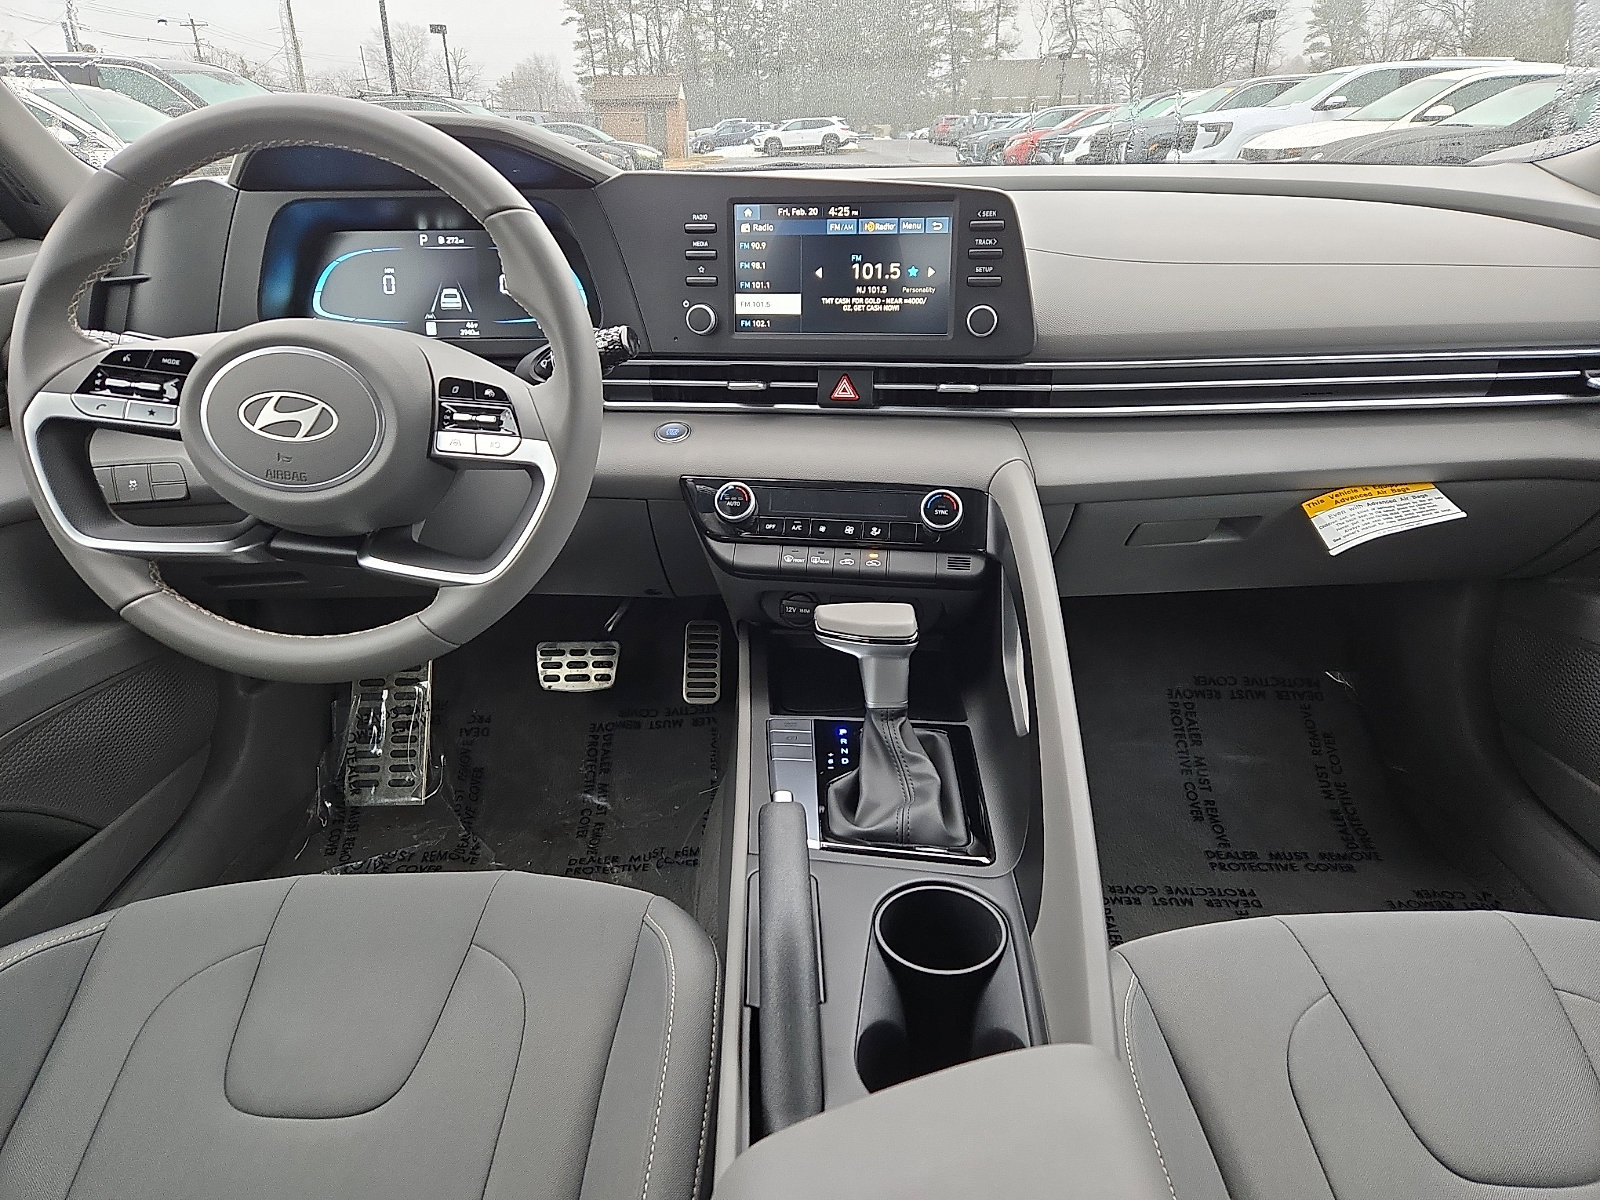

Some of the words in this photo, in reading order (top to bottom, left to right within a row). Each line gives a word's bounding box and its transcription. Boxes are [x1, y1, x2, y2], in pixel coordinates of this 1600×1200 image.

[777, 207, 791, 217] Fri,
[791, 207, 807, 216] Feb.
[808, 207, 819, 216] 20
[828, 206, 851, 217] 4:25
[752, 223, 774, 231] Radio
[829, 223, 854, 231] FM/AM
[902, 221, 921, 230] Menu
[419, 234, 428, 246] P
[739, 242, 750, 250] FM
[750, 241, 767, 250] 90.9
[851, 254, 862, 262] FM
[739, 261, 750, 269] FM
[750, 261, 766, 269] 98.1
[852, 262, 901, 280] 101.5
[382, 274, 396, 295] 0
[739, 281, 750, 289] FM
[751, 281, 770, 289] 101.1
[856, 286, 866, 294] NJ
[867, 286, 888, 294] 101.5
[902, 286, 936, 295] Personality
[834, 297, 851, 305] CASH
[851, 297, 864, 305] FOR
[864, 297, 881, 305] GOLD
[853, 304, 865, 312] GET
[866, 304, 883, 312] CASH
[740, 319, 751, 327] FM
[752, 319, 771, 328] 102.1
[161, 357, 181, 366] MODE
[265, 468, 308, 482] AIRBAG
[1305, 498, 1325, 509] This
[1328, 487, 1359, 500] Vehicle
[1334, 491, 1373, 505] Advanced
[1390, 486, 1411, 494] Bags
[1327, 509, 1347, 519] Even
[1366, 498, 1398, 507] Advanced
[1192, 674, 1238, 688] COVER
[1166, 688, 1221, 701] REMOVE
[1230, 688, 1266, 700] MUST
[648, 718, 684, 730] MUST
[1183, 701, 1203, 748] DEALER
[1301, 702, 1323, 757] REMOVE
[838, 728, 848, 736] P
[840, 747, 849, 755] N
[1323, 731, 1343, 775] COVER
[841, 757, 850, 765] D
[1168, 701, 1193, 777] PROTECTIVE
[1183, 781, 1204, 823] COVER
[1194, 755, 1213, 793] MUST
[1315, 763, 1336, 801] MUST
[1203, 799, 1231, 849] REMOVE
[1329, 808, 1360, 850] DEALER
[421, 849, 479, 866] REMOVE
[568, 855, 620, 866] DEALER
[629, 846, 665, 863] MUST
[674, 846, 701, 860] REM
[1203, 850, 1260, 861] DEALER
[1268, 850, 1309, 861] MUST
[1319, 850, 1384, 862] REMOVE
[564, 862, 651, 876] PROTECTIVE
[1208, 861, 1298, 873] PROTECTIVE
[1304, 861, 1357, 874] COVER
[1107, 884, 1158, 895] COVER
[1163, 885, 1257, 898] PROTECTIVE
[1412, 888, 1467, 900] COVER
[1104, 896, 1142, 907] REMO
[1152, 897, 1194, 908] MUST
[1203, 898, 1264, 909] DEALER
